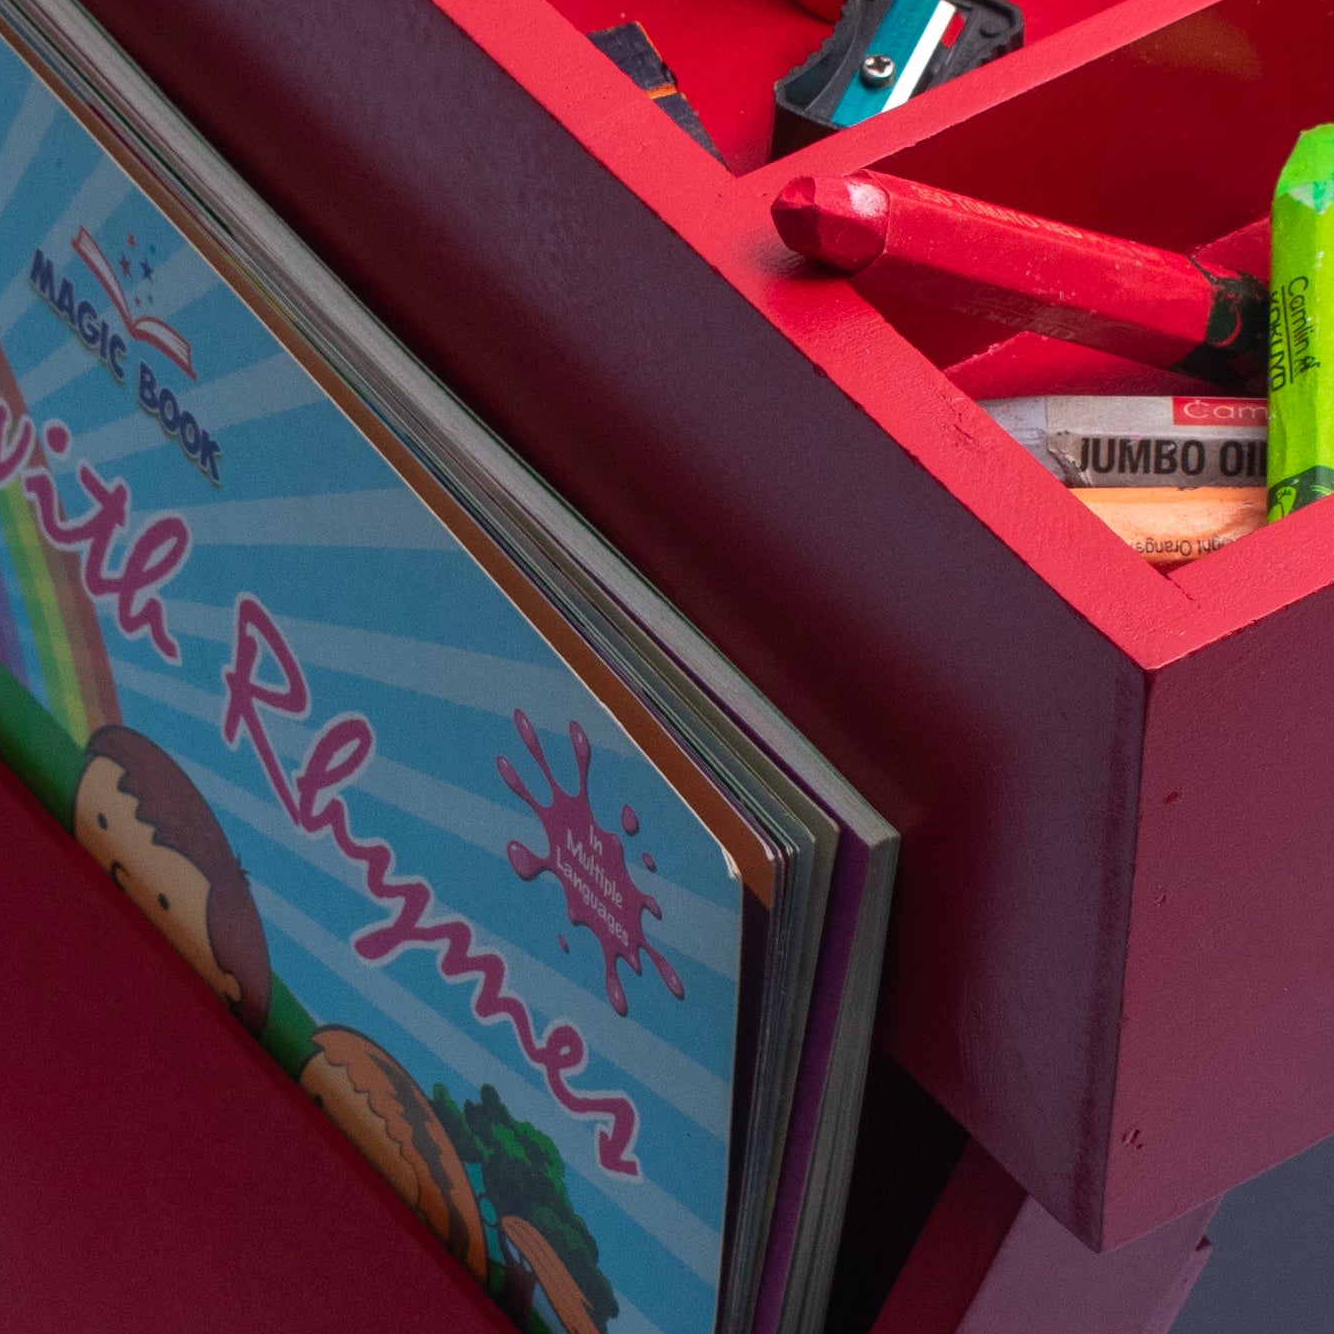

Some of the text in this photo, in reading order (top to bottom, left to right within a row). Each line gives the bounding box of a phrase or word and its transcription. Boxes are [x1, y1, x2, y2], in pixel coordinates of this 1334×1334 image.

[1288, 275, 1314, 356] Camlin
[30, 249, 222, 483] MAGIC BOOK
[1079, 436, 1205, 477] JUMBO
[567, 827, 623, 909] Multiple
[588, 824, 603, 855] In
[222, 595, 640, 1178] Rhymes
[555, 845, 629, 948] Languages
